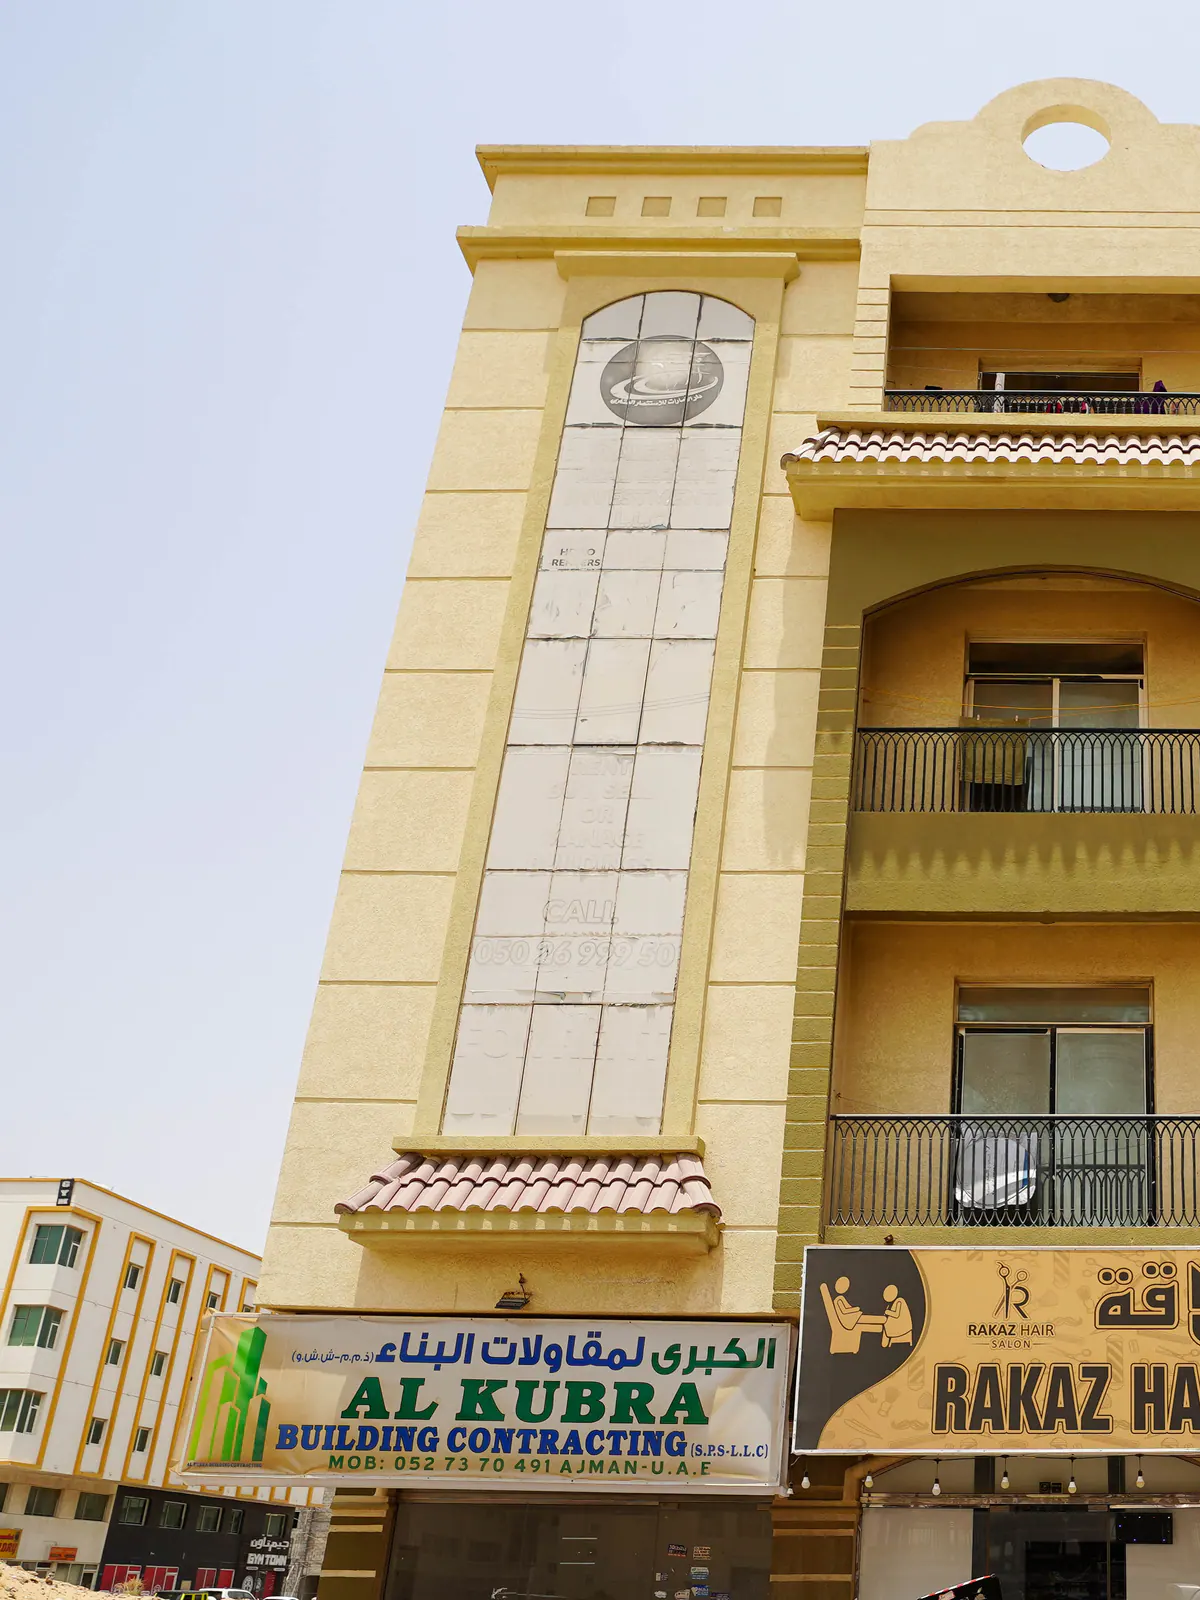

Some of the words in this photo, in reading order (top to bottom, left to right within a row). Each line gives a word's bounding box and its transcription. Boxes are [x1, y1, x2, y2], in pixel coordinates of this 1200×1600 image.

[542, 898, 620, 924] CALL
[968, 1324, 1016, 1336] RAKAZ
[1020, 1324, 1055, 1336] HAIR
[991, 1340, 1031, 1348] SALON
[375, 1332, 475, 1371] البناء
[481, 1331, 645, 1374] لمقاولات
[341, 1376, 439, 1420] AL
[455, 1378, 709, 1425] KUBRA
[931, 1362, 1113, 1435] RAKAZ
[275, 1423, 440, 1453] BUILDING
[446, 1426, 688, 1457] CONTRACTING
[328, 1455, 385, 1470] MOB:
[394, 1456, 435, 1471] 052
[444, 1456, 469, 1472] 73
[479, 1457, 505, 1473] 70
[514, 1458, 550, 1474] 491
[246, 1552, 265, 1565] GYM
[264, 1554, 288, 1566] TOWN
